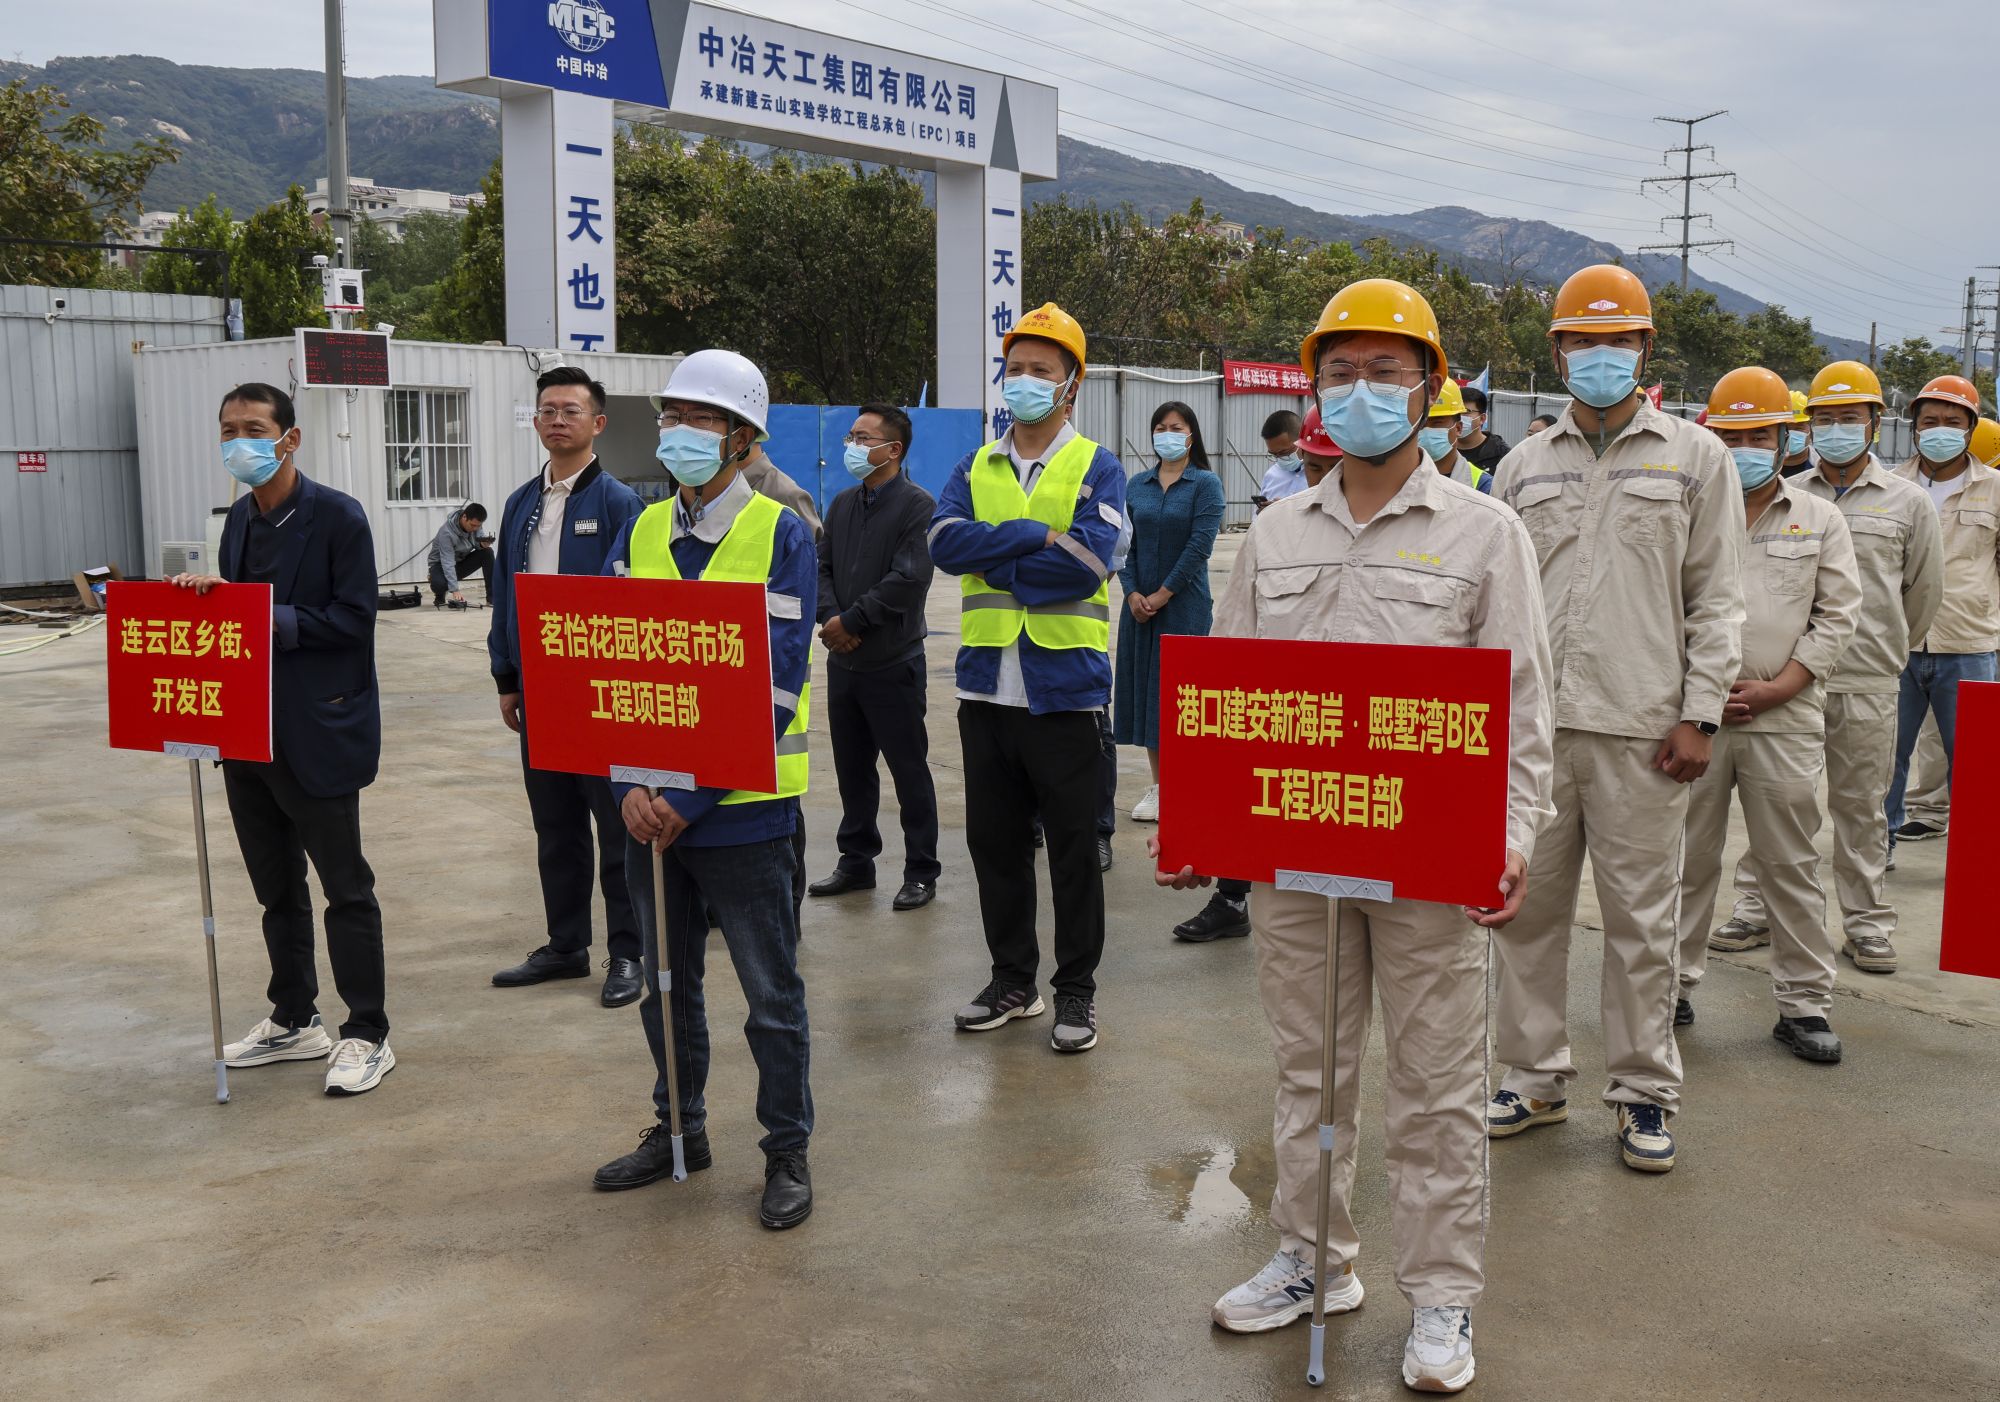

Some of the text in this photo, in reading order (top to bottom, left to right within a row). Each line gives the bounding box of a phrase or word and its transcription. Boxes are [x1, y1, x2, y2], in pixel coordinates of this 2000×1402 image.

[549, 3, 615, 38] MCC
[556, 54, 608, 81] 中国中冶
[699, 26, 976, 120] 中冶天工集团有限公司
[120, 616, 252, 661] 连云区乡街、
[539, 611, 745, 668] 茗怡花园农贸市场
[151, 677, 224, 717] 开发区
[590, 679, 700, 729] 工程项目部
[1251, 767, 1404, 831] 工程项目部
